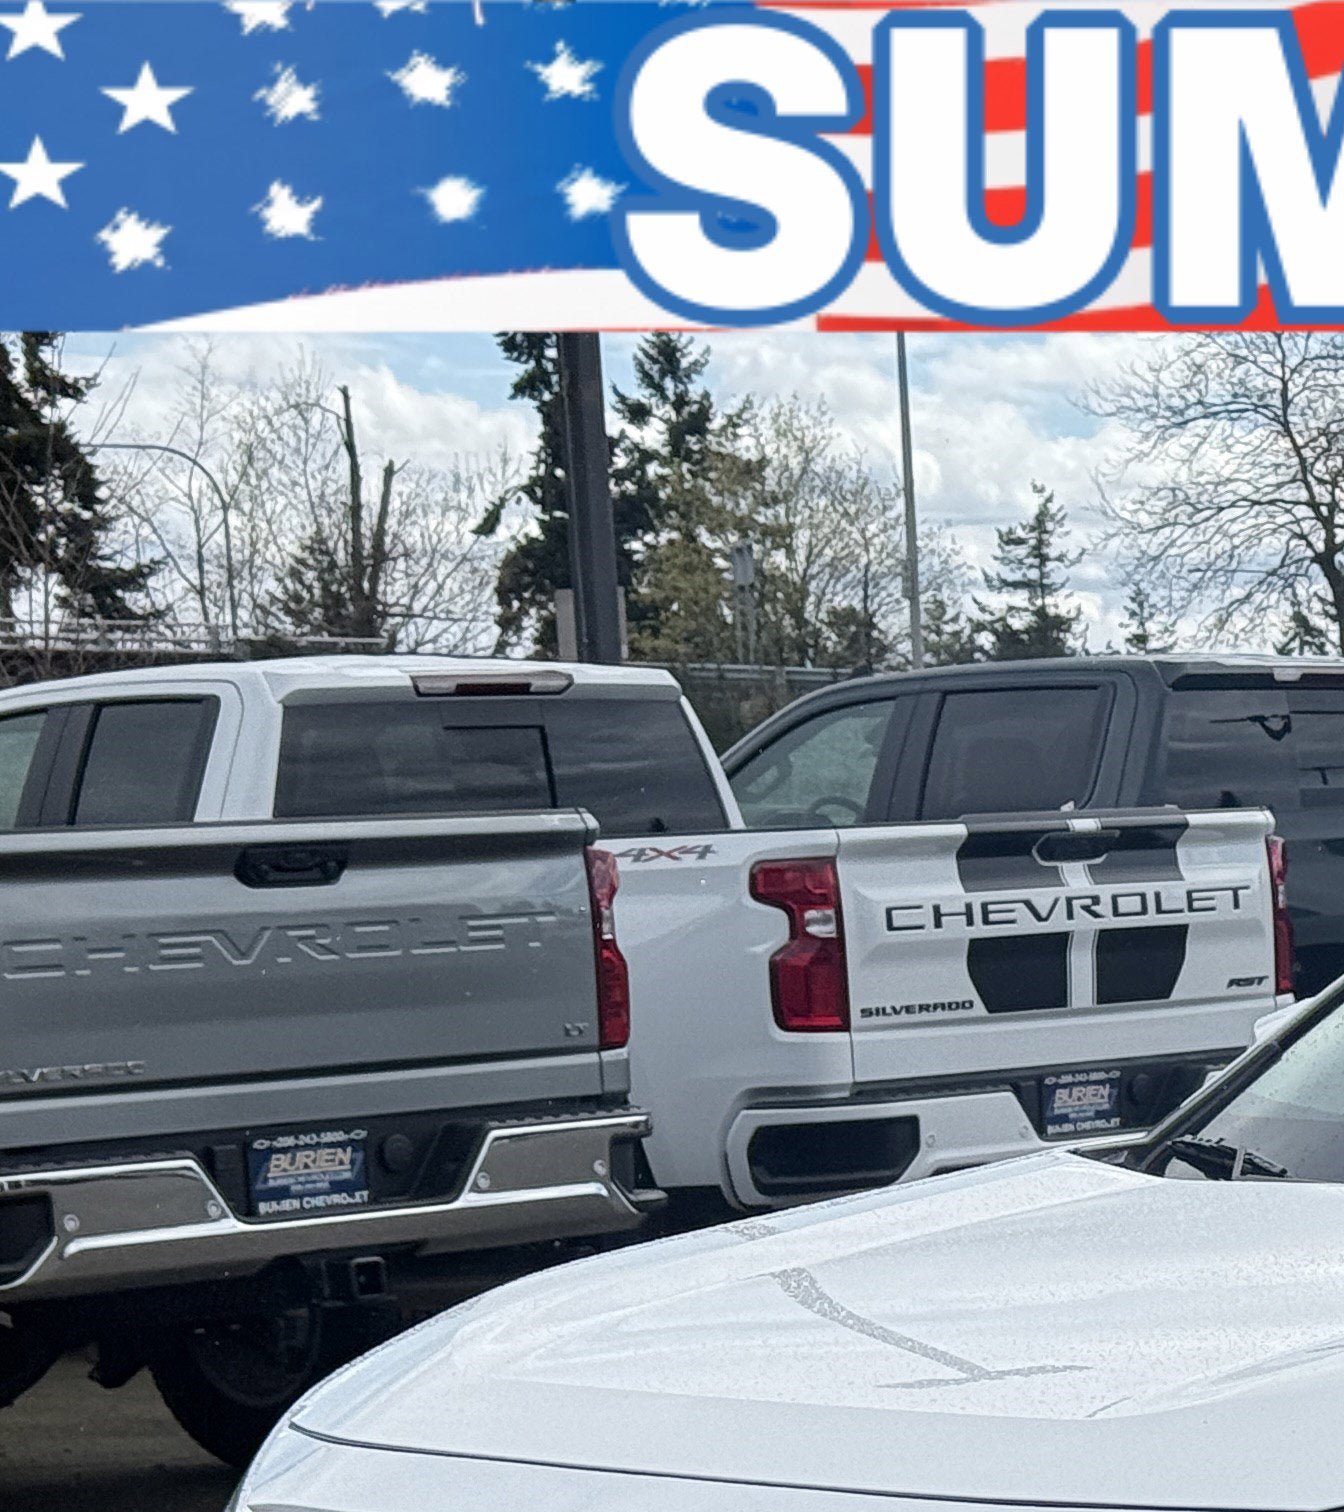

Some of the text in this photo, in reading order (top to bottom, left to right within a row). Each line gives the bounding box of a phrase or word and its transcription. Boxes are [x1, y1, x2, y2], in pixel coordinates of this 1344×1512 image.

[886, 885, 1251, 932] CHEVROLET
[2, 910, 559, 979] CHEVROLET
[1226, 975, 1269, 989] RST
[859, 999, 975, 1019] SILVERADO
[1055, 1083, 1110, 1104] BURIEN
[269, 1146, 353, 1173] BURIEN
